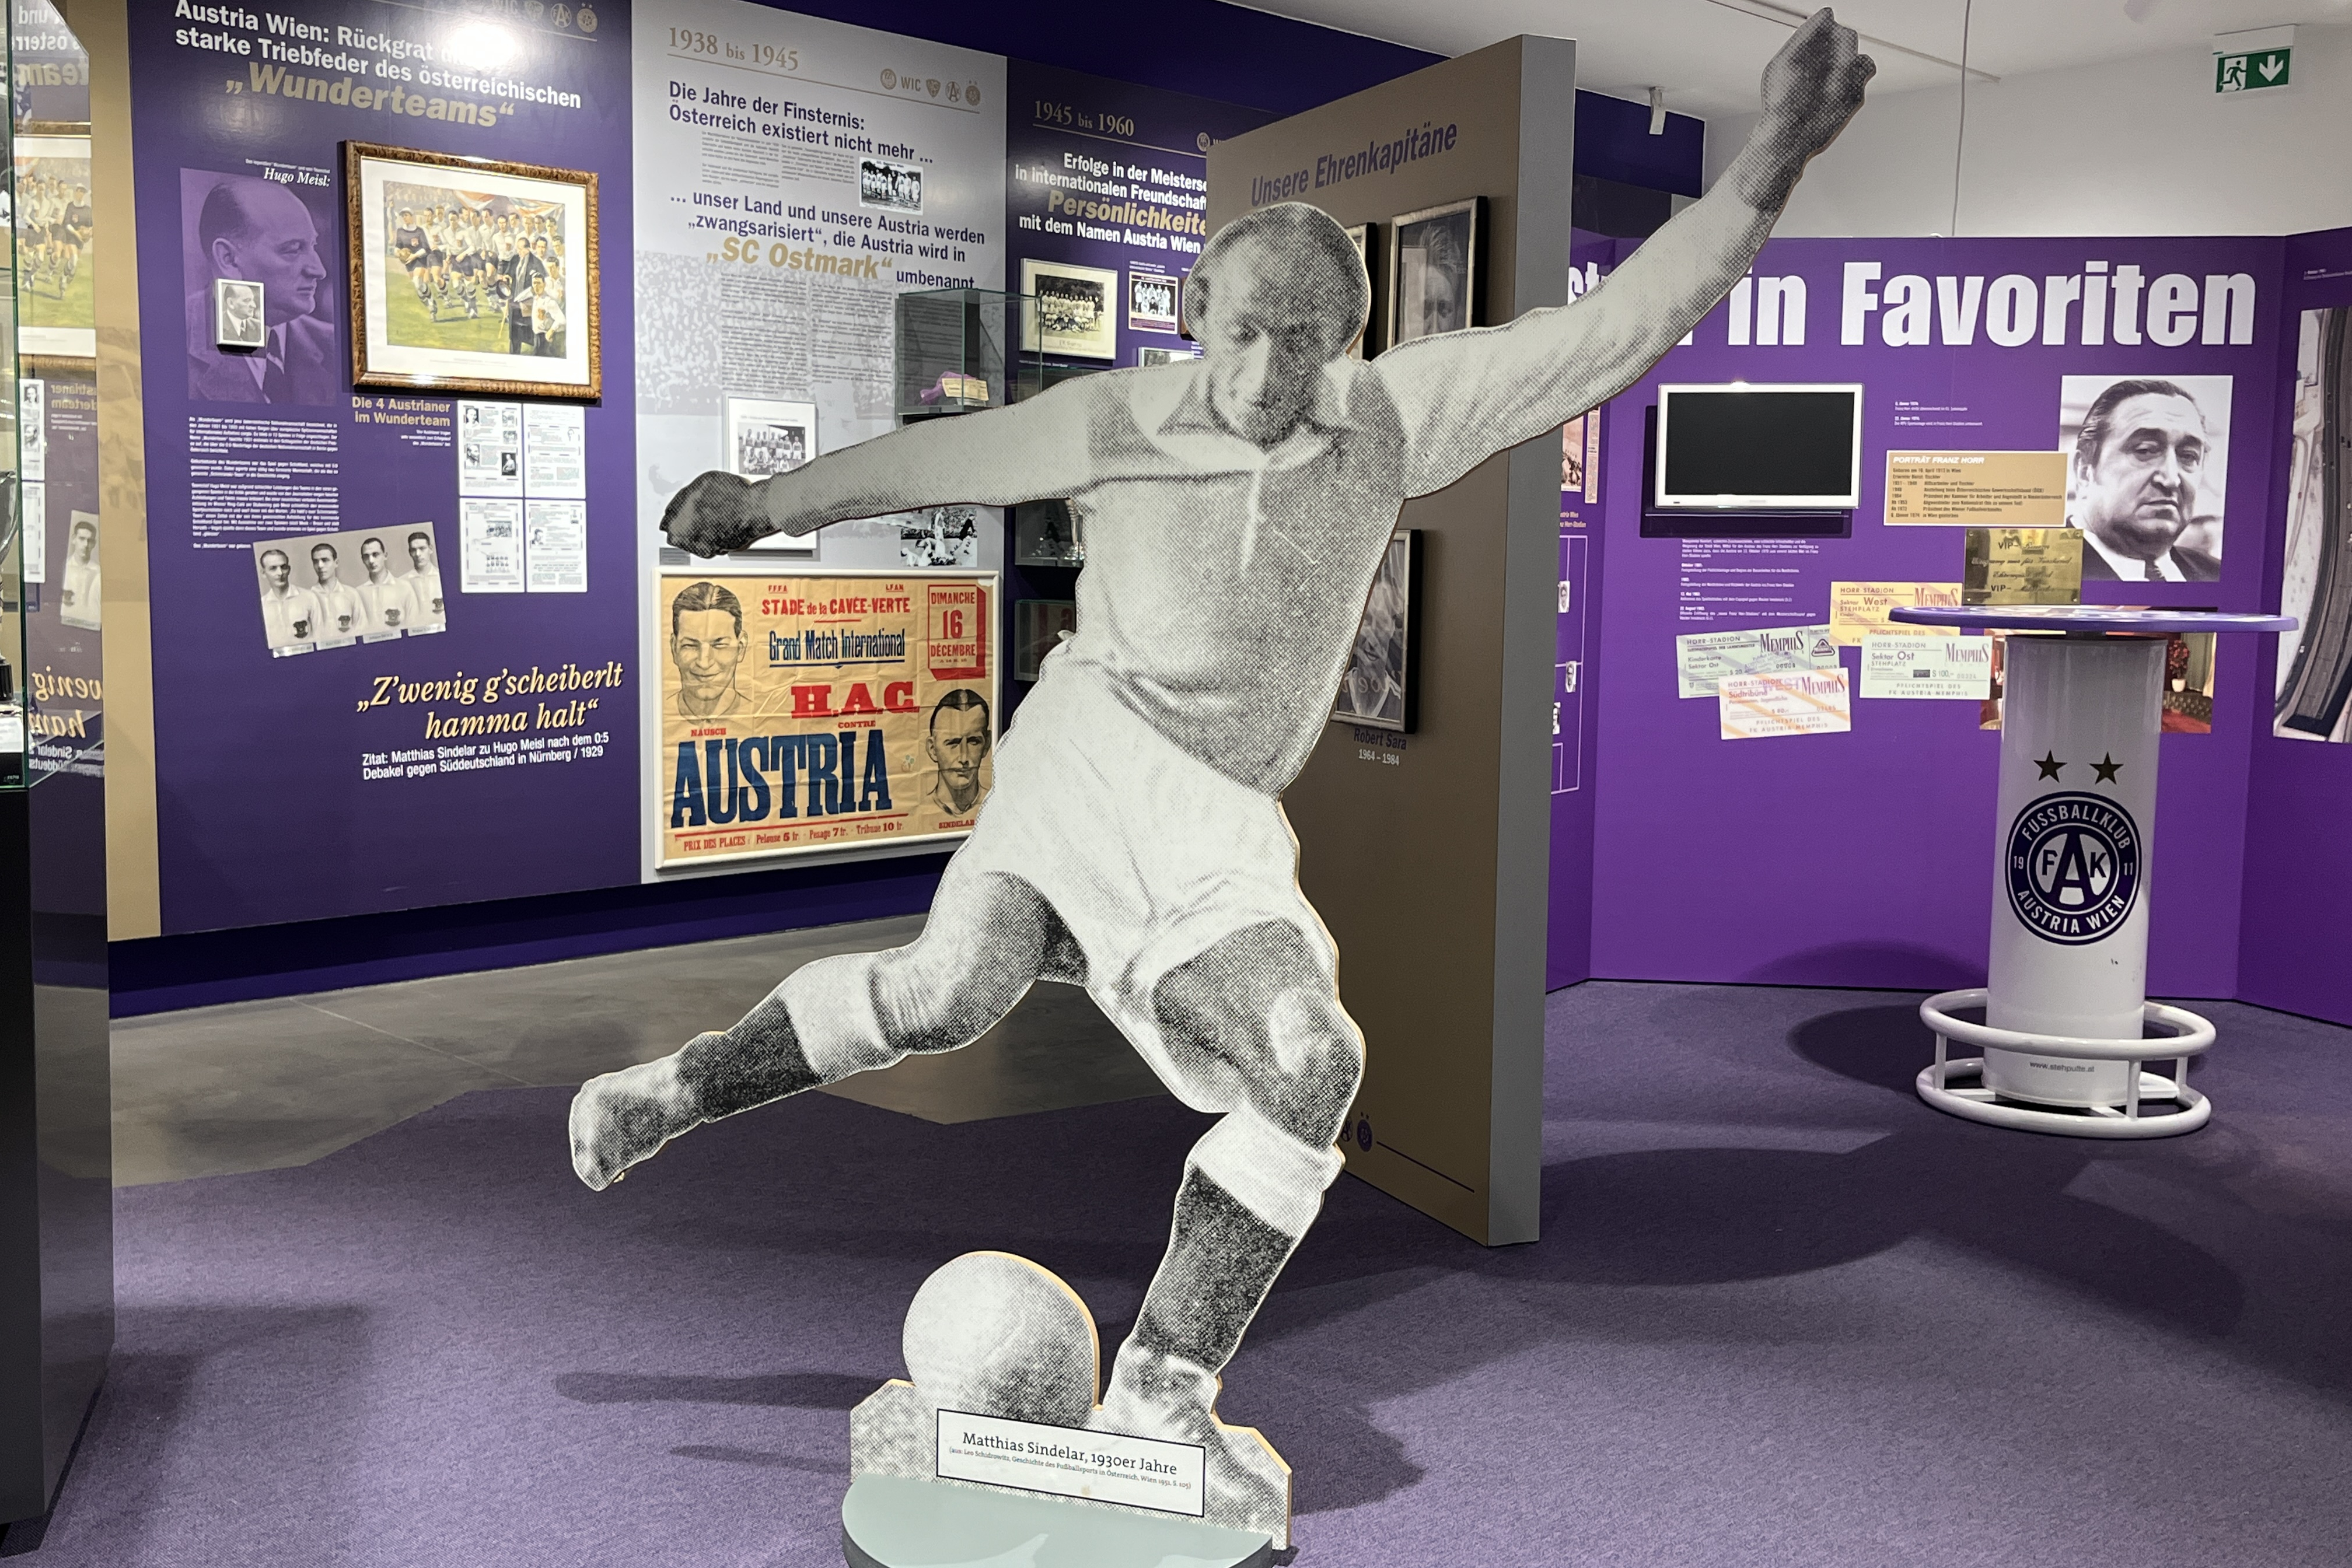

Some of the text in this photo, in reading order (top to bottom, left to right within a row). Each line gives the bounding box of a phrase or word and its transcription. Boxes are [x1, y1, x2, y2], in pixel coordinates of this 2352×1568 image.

[175, 0, 258, 30] Austria
[266, 13, 329, 43] Wien:
[337, 26, 434, 61] Rückgrat
[669, 27, 799, 71] 1938 bis 1945
[176, 27, 581, 108] starke Triebfeder des österreichischen
[226, 61, 515, 127] „Wunderteams“
[901, 76, 921, 92] WIC
[670, 80, 865, 131] Die Jahre der Finsternis:
[1035, 100, 1134, 136] 1945 bis 1960
[670, 99, 915, 161] Österreich existiert nicht mehr
[264, 167, 331, 187] Hugo Meisl:
[1064, 152, 1109, 177] Erfolge
[1113, 161, 1124, 178] in
[1127, 164, 1147, 181] der
[1251, 121, 1458, 207] Unsere Ehrenkapitäne
[1015, 164, 1027, 181] in
[1032, 166, 1127, 198] internationalen
[693, 191, 985, 245] unser Land und unsere Austria werden
[833, 231, 855, 249] die
[861, 233, 913, 256] Austria
[918, 242, 948, 261] wird
[953, 245, 965, 262] in
[1019, 214, 1201, 254] mit dem Namen Austria Wien
[706, 236, 892, 279] „SC Ostmark“
[896, 268, 974, 289] umbenannt
[1728, 261, 2255, 346] in Favoriten
[352, 396, 450, 413] Die 4 Austrianer
[355, 410, 450, 427] im Wunderteam
[1893, 456, 1931, 464] PORTRÄT
[1932, 456, 1959, 464] FRANZ
[761, 597, 910, 615] STADE de la CAVÉE-VERTE
[931, 592, 976, 605] DIMANCHE
[1863, 597, 1888, 606] West
[1914, 587, 1958, 607] MEMPHIS
[943, 610, 963, 639] 16
[770, 628, 905, 661] Grand Match International
[931, 643, 976, 657] DÉCEMBRE
[1760, 631, 1804, 652] MEMPHIS
[1871, 650, 1914, 660] Sektor Ost
[1946, 643, 1989, 663] MEMPHIS
[1802, 674, 1845, 695] MEMPHIS
[425, 698, 599, 740] hamma halt“
[691, 728, 726, 737] NAUSCH
[838, 720, 876, 730] CONTRE
[362, 732, 609, 766] Zitat: Matthias Sindelar zu Hugo Meisl nach dem 0:5
[1354, 728, 1407, 750] Robert Sara
[364, 746, 603, 780] Debakel gegen Süddeutschland in Nürnberg 1929
[1358, 748, 1400, 766] 1964 1984
[671, 729, 892, 829] AUSTRIA
[684, 841, 701, 851] PRIX
[704, 839, 717, 849] DES
[719, 836, 746, 848] PLACES
[756, 834, 781, 845] Pelouse
[809, 830, 831, 841] Pesage
[833, 827, 839, 837] 7
[856, 824, 881, 835] Tribune
[883, 822, 894, 832] 10
[2022, 804, 2130, 849] FUSSBALLKLUB
[2014, 856, 2024, 869] 19
[2124, 863, 2133, 876] 11
[2018, 890, 2125, 933] AUSTRIA WIEN
[963, 1432, 1177, 1475] Matthias Sindelar, 1930er Jahre
[1012, 1456, 1044, 1466] Geschichte
[1057, 1462, 1098, 1475] Fußballsports
[1141, 1475, 1157, 1484] Wien
